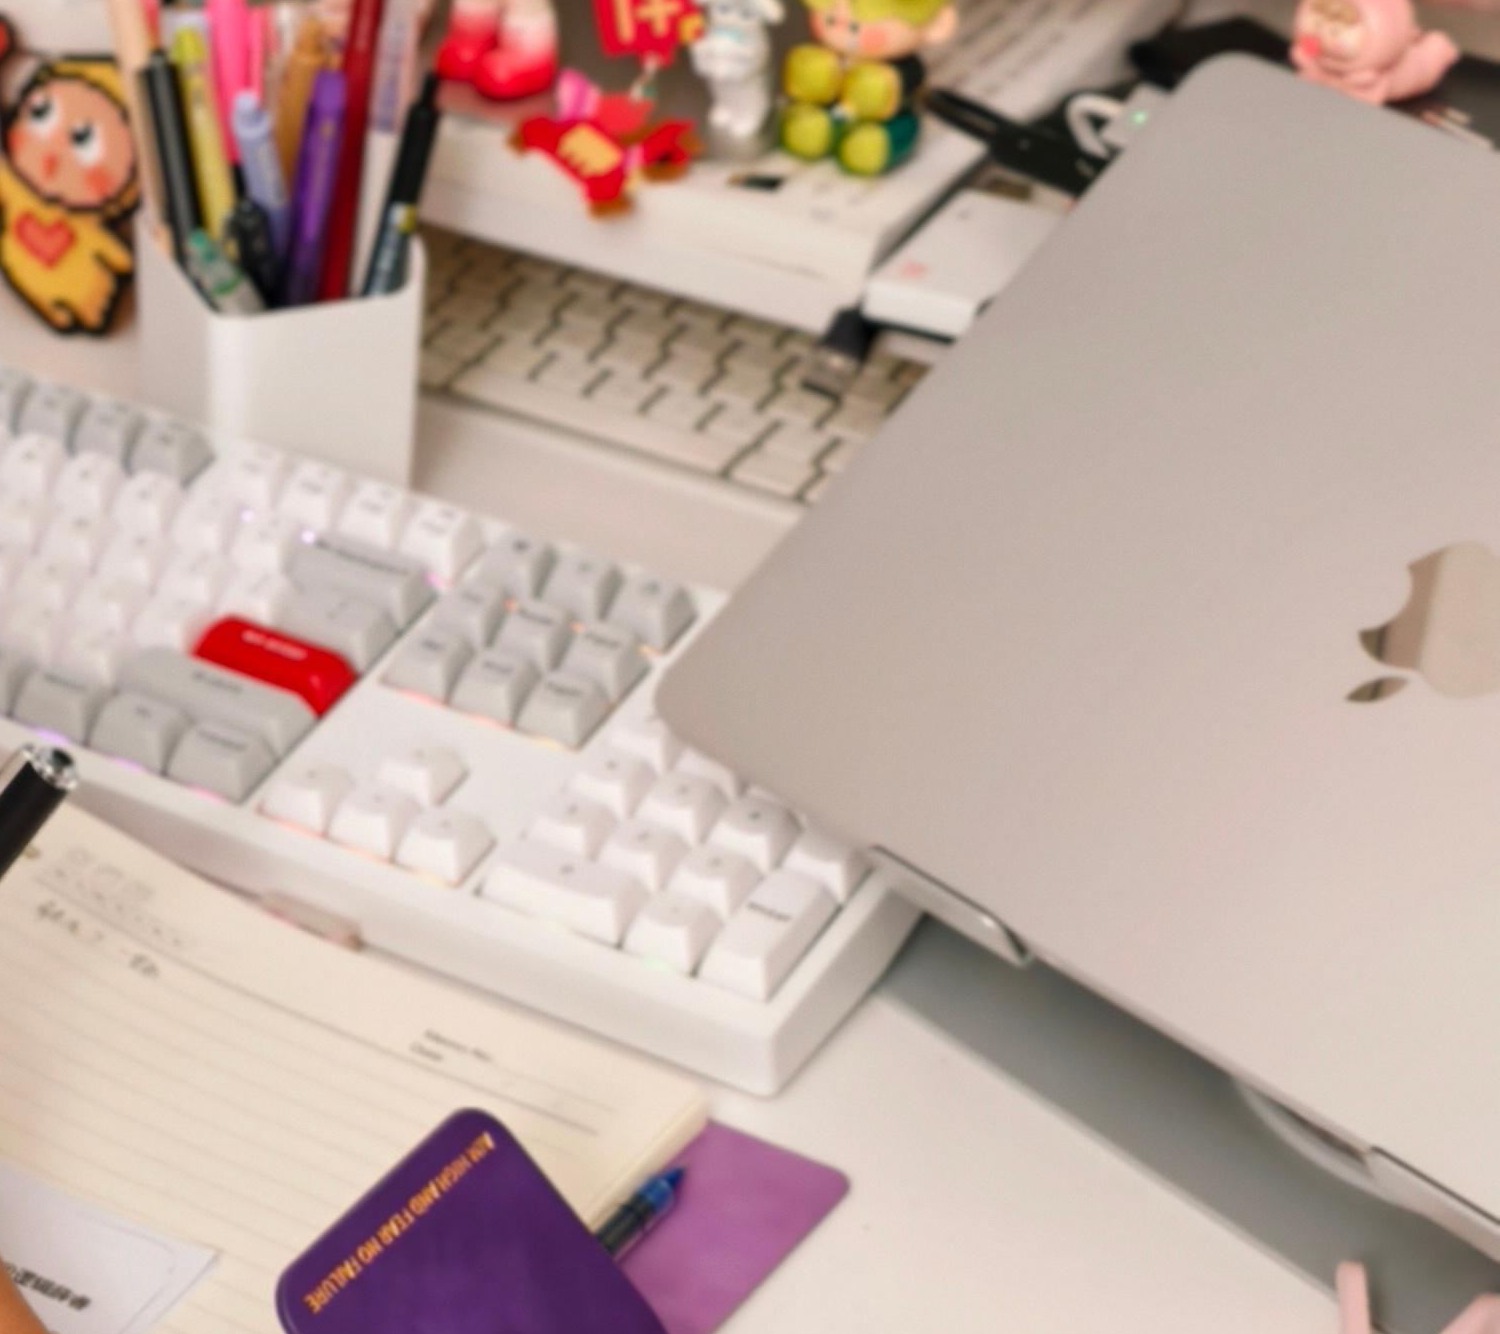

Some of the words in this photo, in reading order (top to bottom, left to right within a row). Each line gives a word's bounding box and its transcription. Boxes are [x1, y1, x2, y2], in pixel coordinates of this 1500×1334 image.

[467, 1131, 496, 1164] AIM
[434, 1154, 472, 1193] HIGH
[408, 1179, 442, 1216] AND
[376, 1207, 416, 1247] FEAR
[354, 1235, 384, 1265] NO
[303, 1255, 363, 1316] FAILURE
